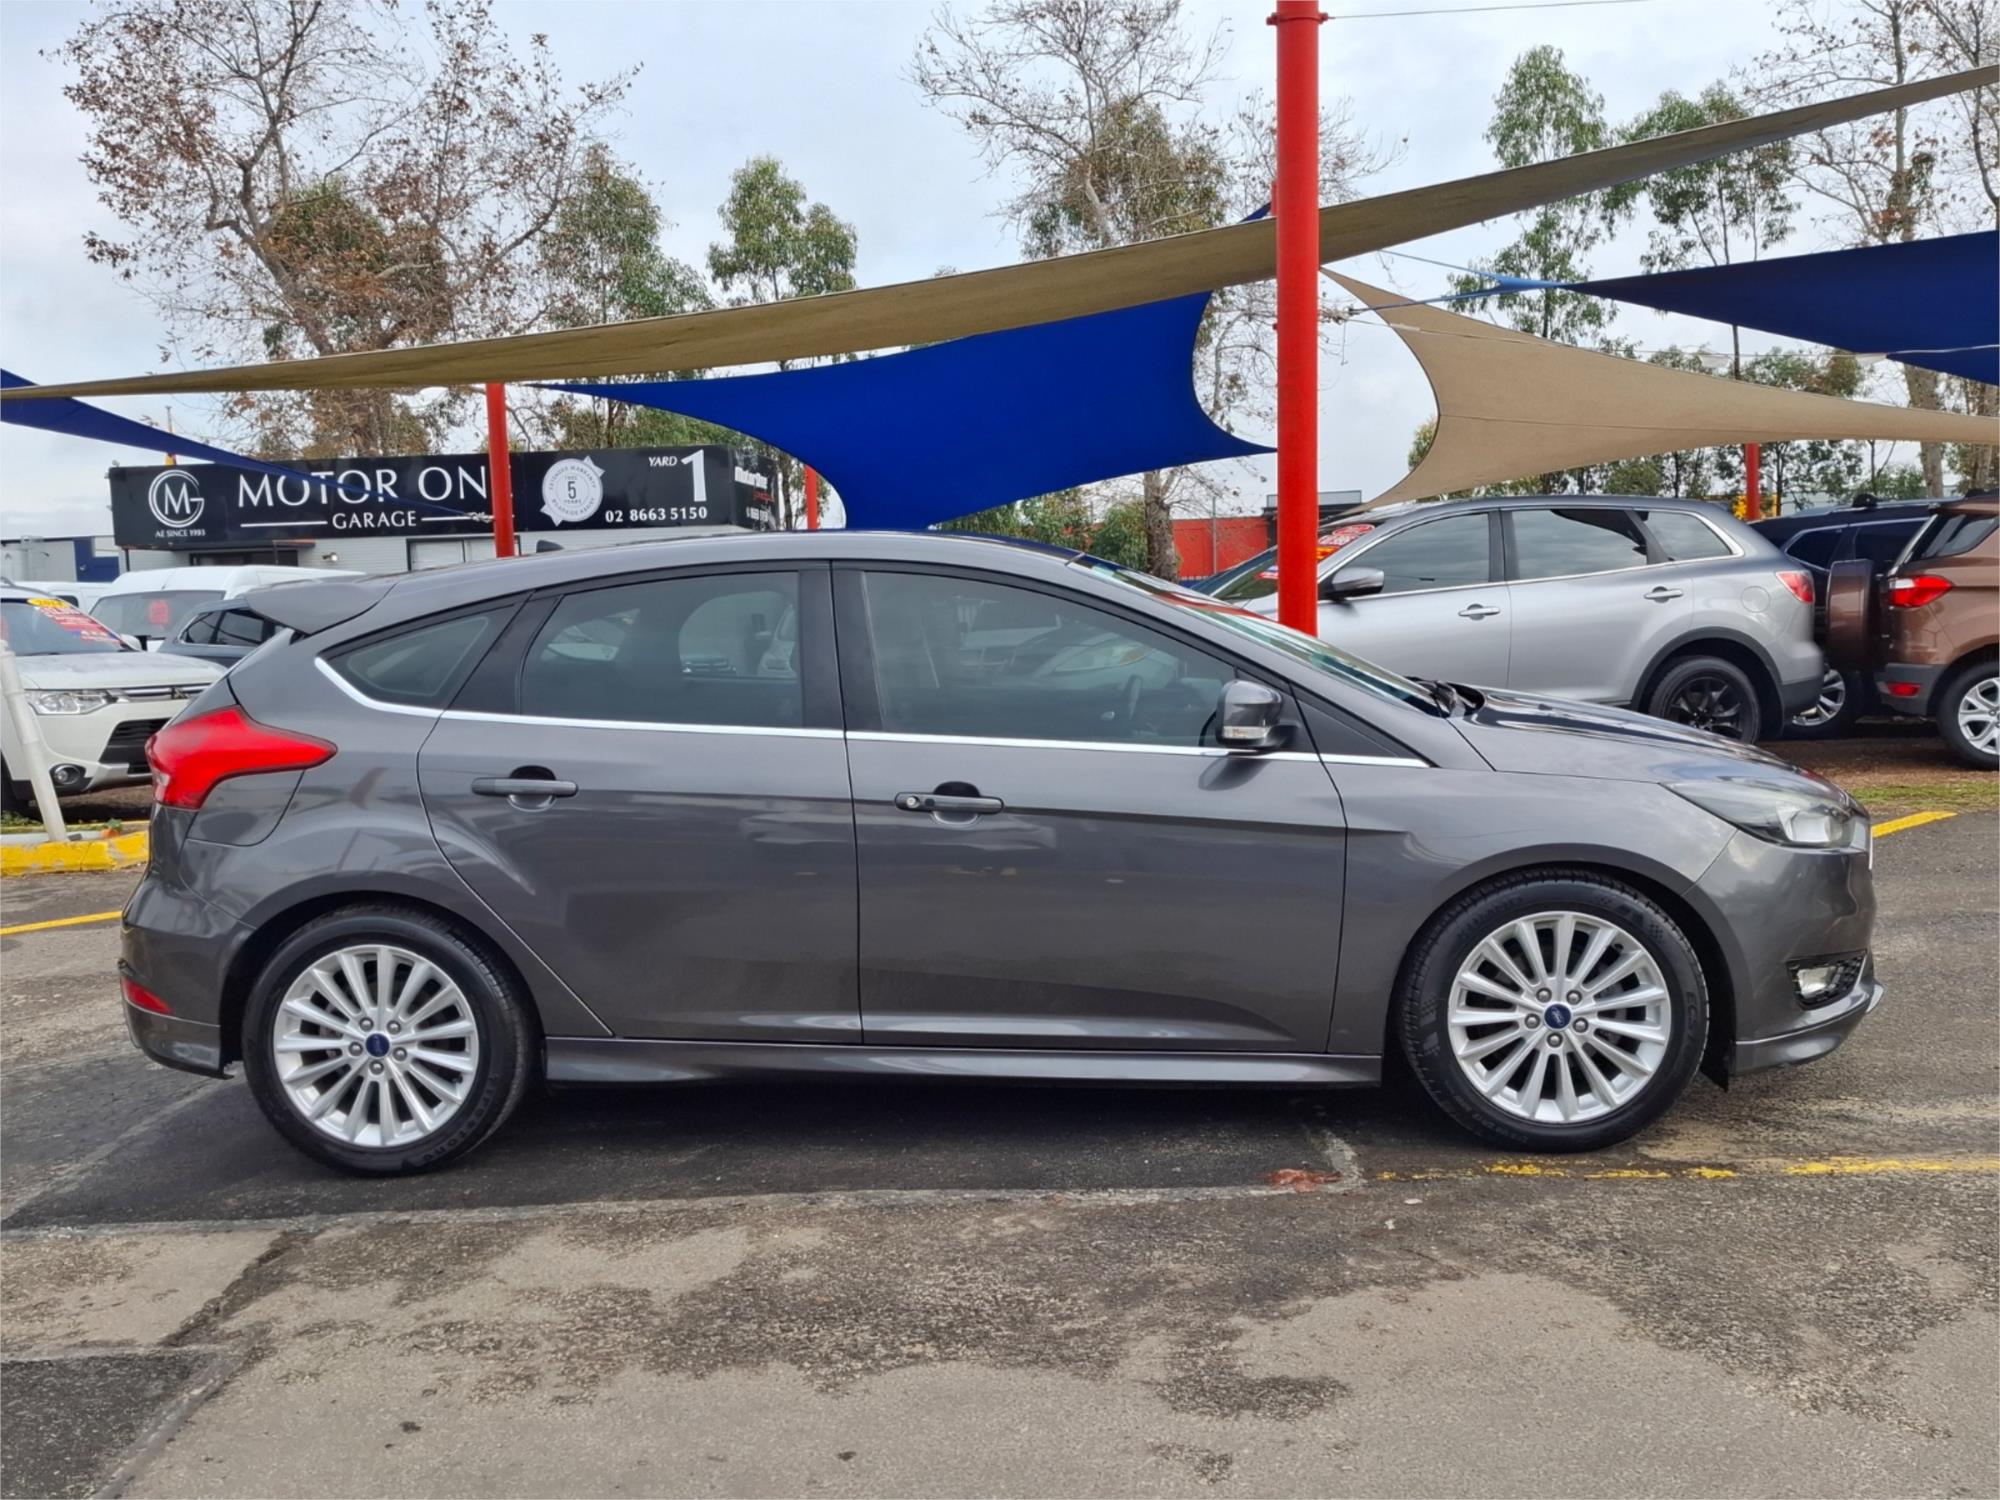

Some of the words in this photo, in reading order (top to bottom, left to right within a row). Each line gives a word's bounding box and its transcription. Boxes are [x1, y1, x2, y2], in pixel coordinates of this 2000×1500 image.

[648, 455, 678, 467] YARD
[680, 449, 707, 502] 1
[238, 470, 398, 507] MOTOR
[567, 480, 577, 500] 5
[332, 510, 418, 529] GARAGE
[605, 510, 624, 523] 02
[629, 507, 666, 521] 8663
[670, 506, 708, 520] 5150
